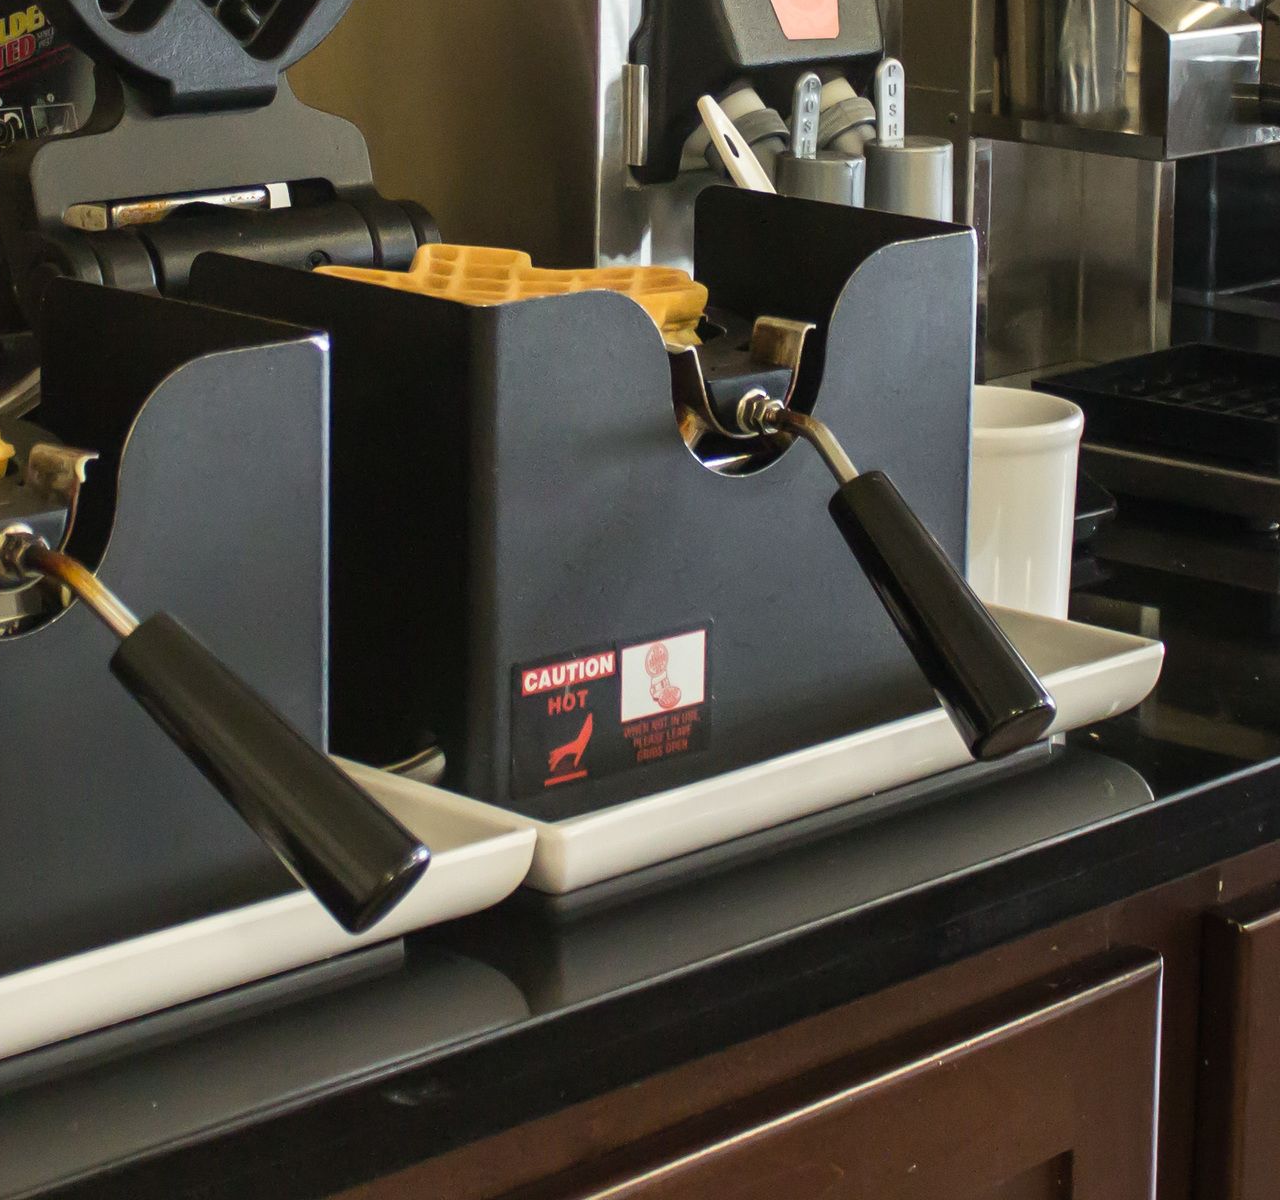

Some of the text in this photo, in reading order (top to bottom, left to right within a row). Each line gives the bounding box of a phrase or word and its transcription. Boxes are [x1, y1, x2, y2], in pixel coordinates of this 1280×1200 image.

[887, 64, 899, 138] PUSH
[524, 655, 614, 692] CAUTION
[547, 689, 589, 717] HOT
